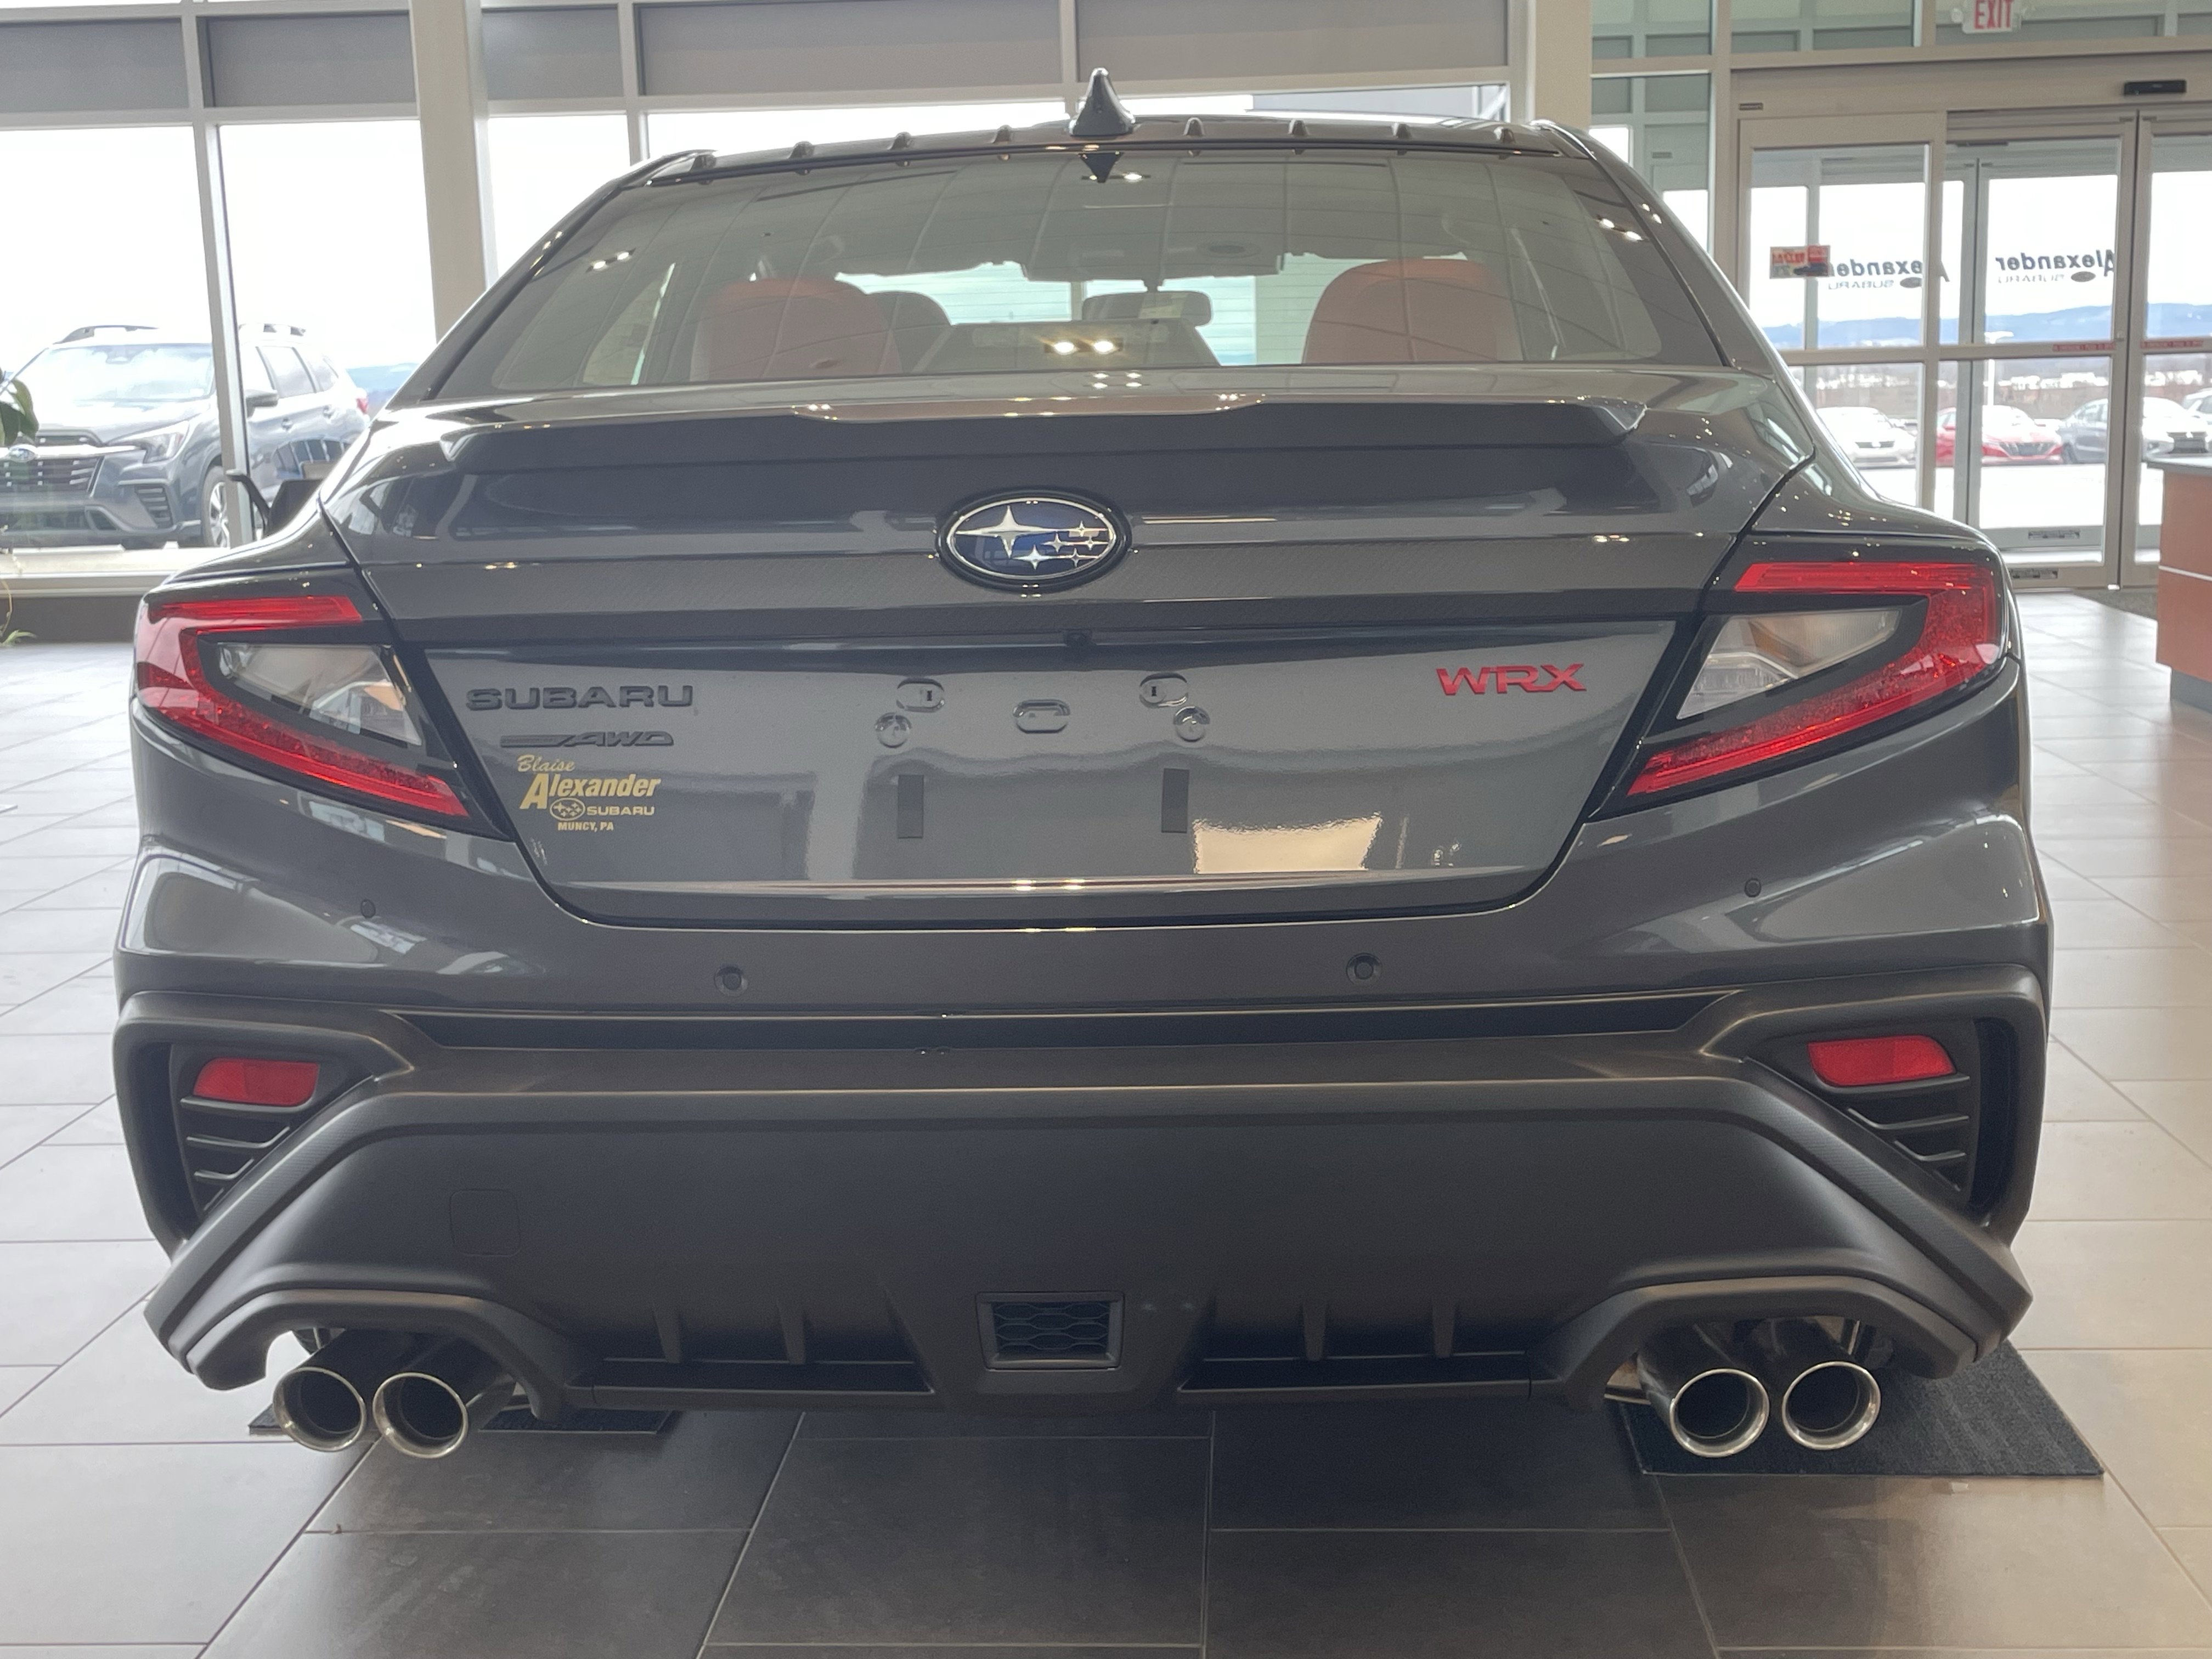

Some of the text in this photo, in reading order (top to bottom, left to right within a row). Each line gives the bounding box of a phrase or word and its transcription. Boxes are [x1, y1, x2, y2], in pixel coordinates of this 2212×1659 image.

[1974, 0, 2013, 29] EXIT
[1436, 663, 1587, 696] WRX
[466, 685, 693, 710] SUBARU
[563, 731, 674, 747] AWD
[517, 754, 575, 772] Blaise
[520, 774, 661, 809] Alexander
[586, 805, 655, 816] SUBARU
[557, 821, 614, 832] MUNCY, PA
